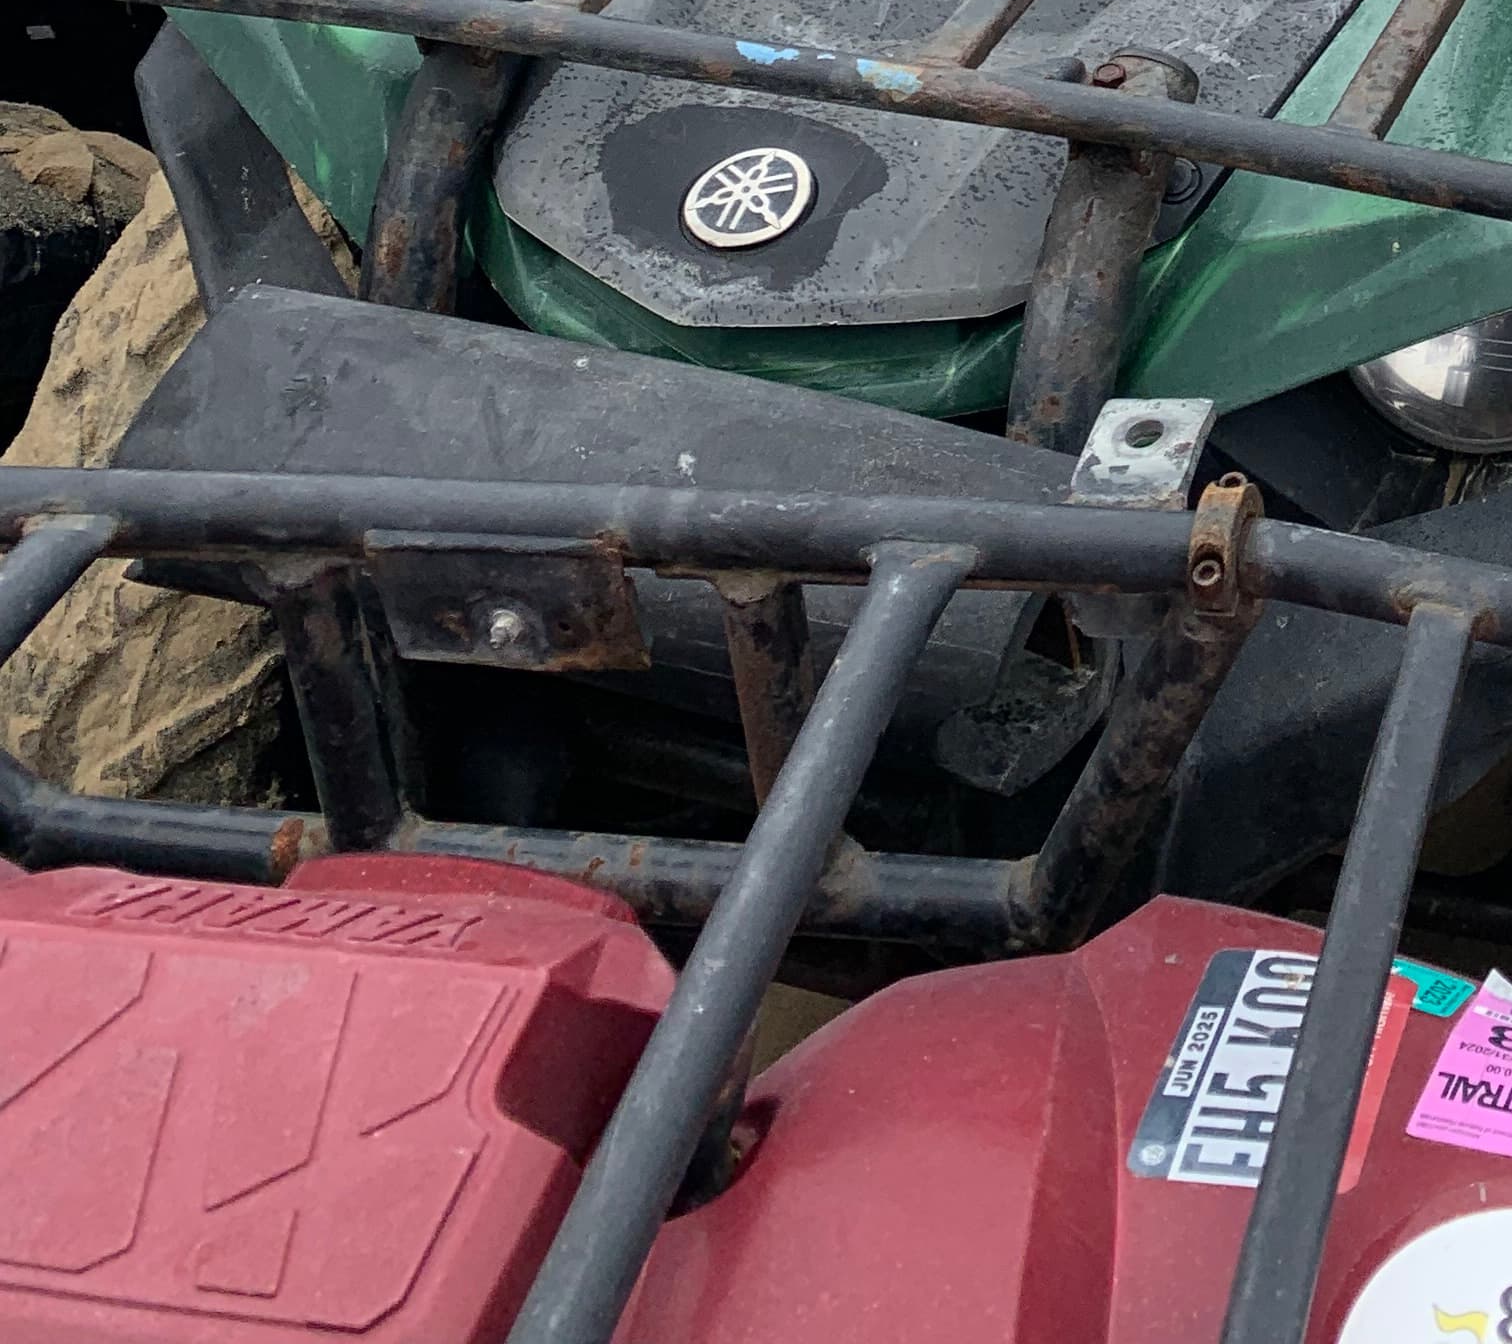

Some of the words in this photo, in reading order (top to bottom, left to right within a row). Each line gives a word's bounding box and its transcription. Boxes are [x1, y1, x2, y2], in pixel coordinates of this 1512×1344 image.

[69, 883, 484, 951] YAMAHA
[1171, 1059, 1198, 1092] JUN
[1187, 1011, 1218, 1053] 2025
